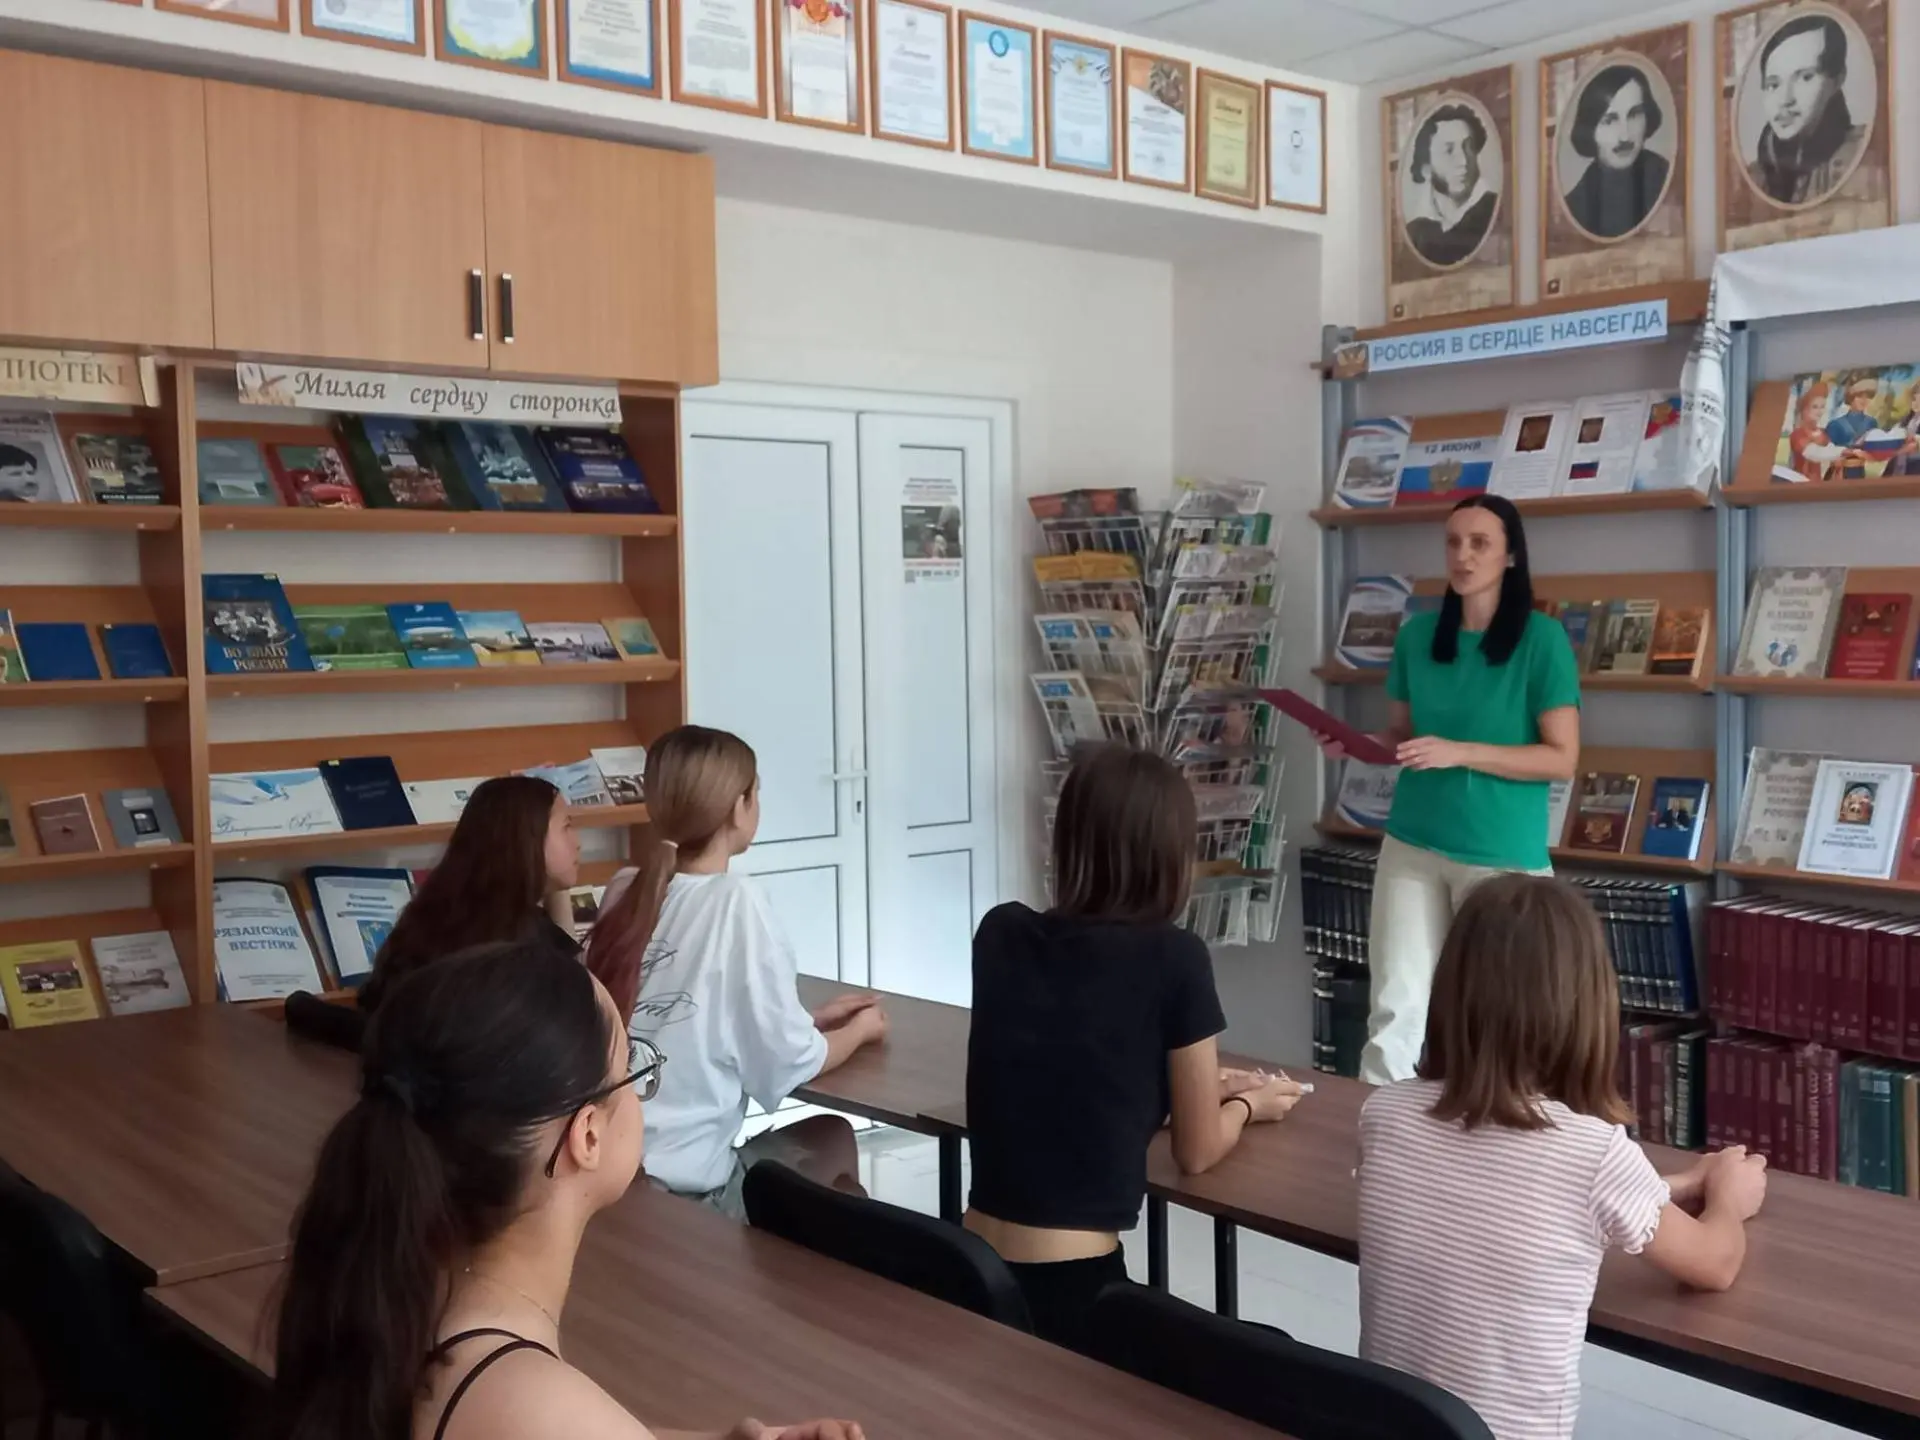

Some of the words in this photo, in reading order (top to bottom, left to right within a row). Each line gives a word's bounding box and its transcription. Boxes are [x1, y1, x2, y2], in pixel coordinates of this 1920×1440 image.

[1373, 337, 1446, 364] РОССИЯ
[1451, 335, 1464, 355] В
[1469, 324, 1545, 352] СЕРДЦЕ
[1550, 308, 1663, 341] НАВСЕГДА
[294, 371, 387, 401] Милая
[409, 382, 489, 414] сердцу
[509, 392, 618, 419] сторонка
[214, 924, 300, 938] РЯЗАНСКИЙ
[228, 940, 298, 952] ВЕСТНИК
